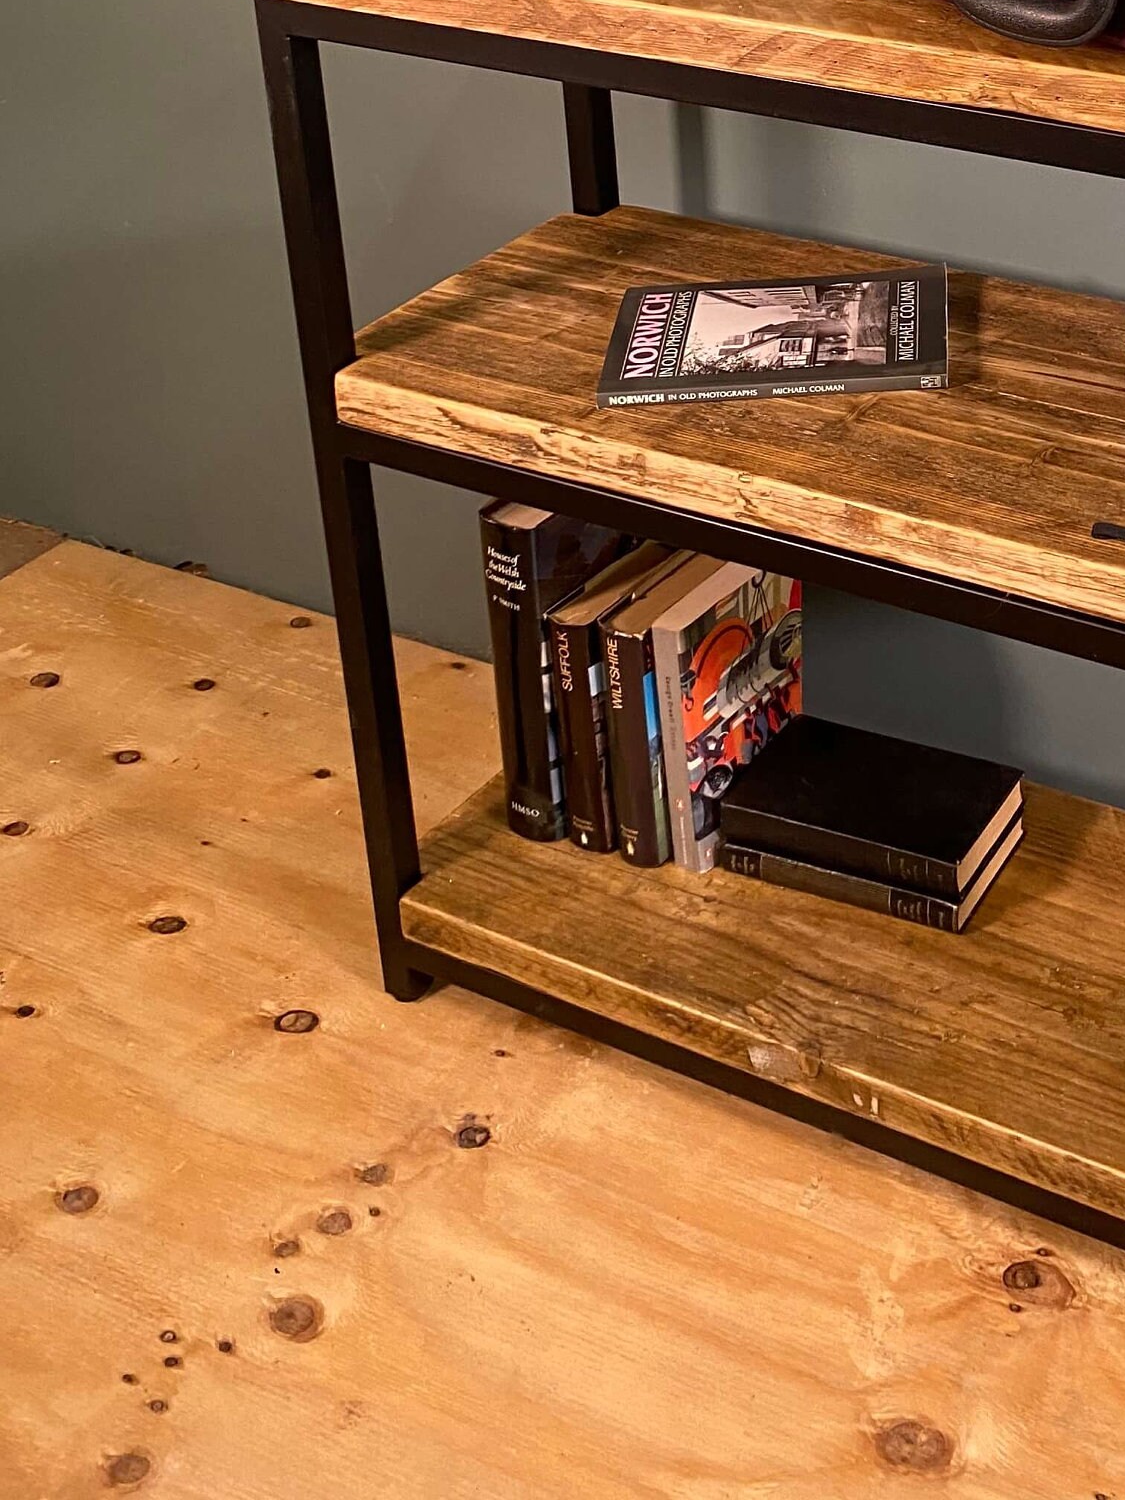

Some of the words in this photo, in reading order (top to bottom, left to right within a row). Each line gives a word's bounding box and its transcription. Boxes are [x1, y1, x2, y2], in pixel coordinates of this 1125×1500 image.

[900, 281, 915, 319] COLMAN
[666, 291, 694, 347] PHOTOGRAPHS
[623, 292, 673, 379] NORWICH
[899, 320, 914, 361] MICHAEL
[658, 367, 673, 377] IN
[661, 347, 678, 367] OLD
[608, 393, 665, 406] NORWICH
[668, 393, 677, 401] IN
[679, 392, 697, 401] OLD
[698, 389, 758, 400] PHOTOGRAPHS
[772, 386, 808, 396] MICHAEL
[809, 383, 845, 393] COLMAN
[487, 546, 511, 563] Houses
[510, 554, 521, 568] of
[485, 568, 527, 591] Countryside
[556, 630, 574, 692] SUFFOLK
[607, 637, 624, 709] WILTSHIRE
[511, 800, 541, 818] HMSO
